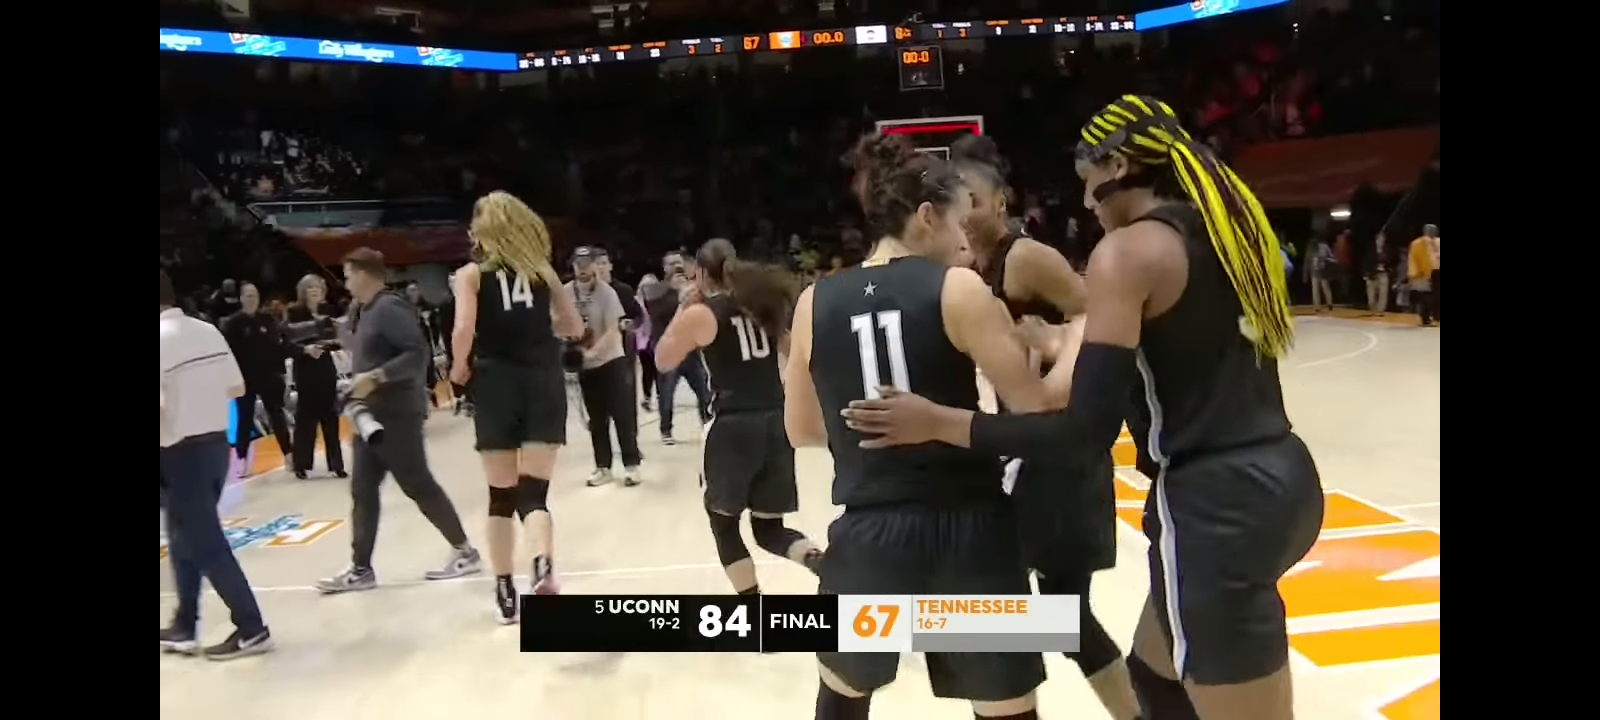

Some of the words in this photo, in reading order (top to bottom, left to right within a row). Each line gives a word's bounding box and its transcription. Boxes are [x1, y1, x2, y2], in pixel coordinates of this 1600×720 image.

[743, 36, 760, 50] 67
[813, 31, 845, 45] 00.0
[496, 269, 534, 312] 14
[730, 315, 771, 361] 10
[850, 309, 912, 401] 11
